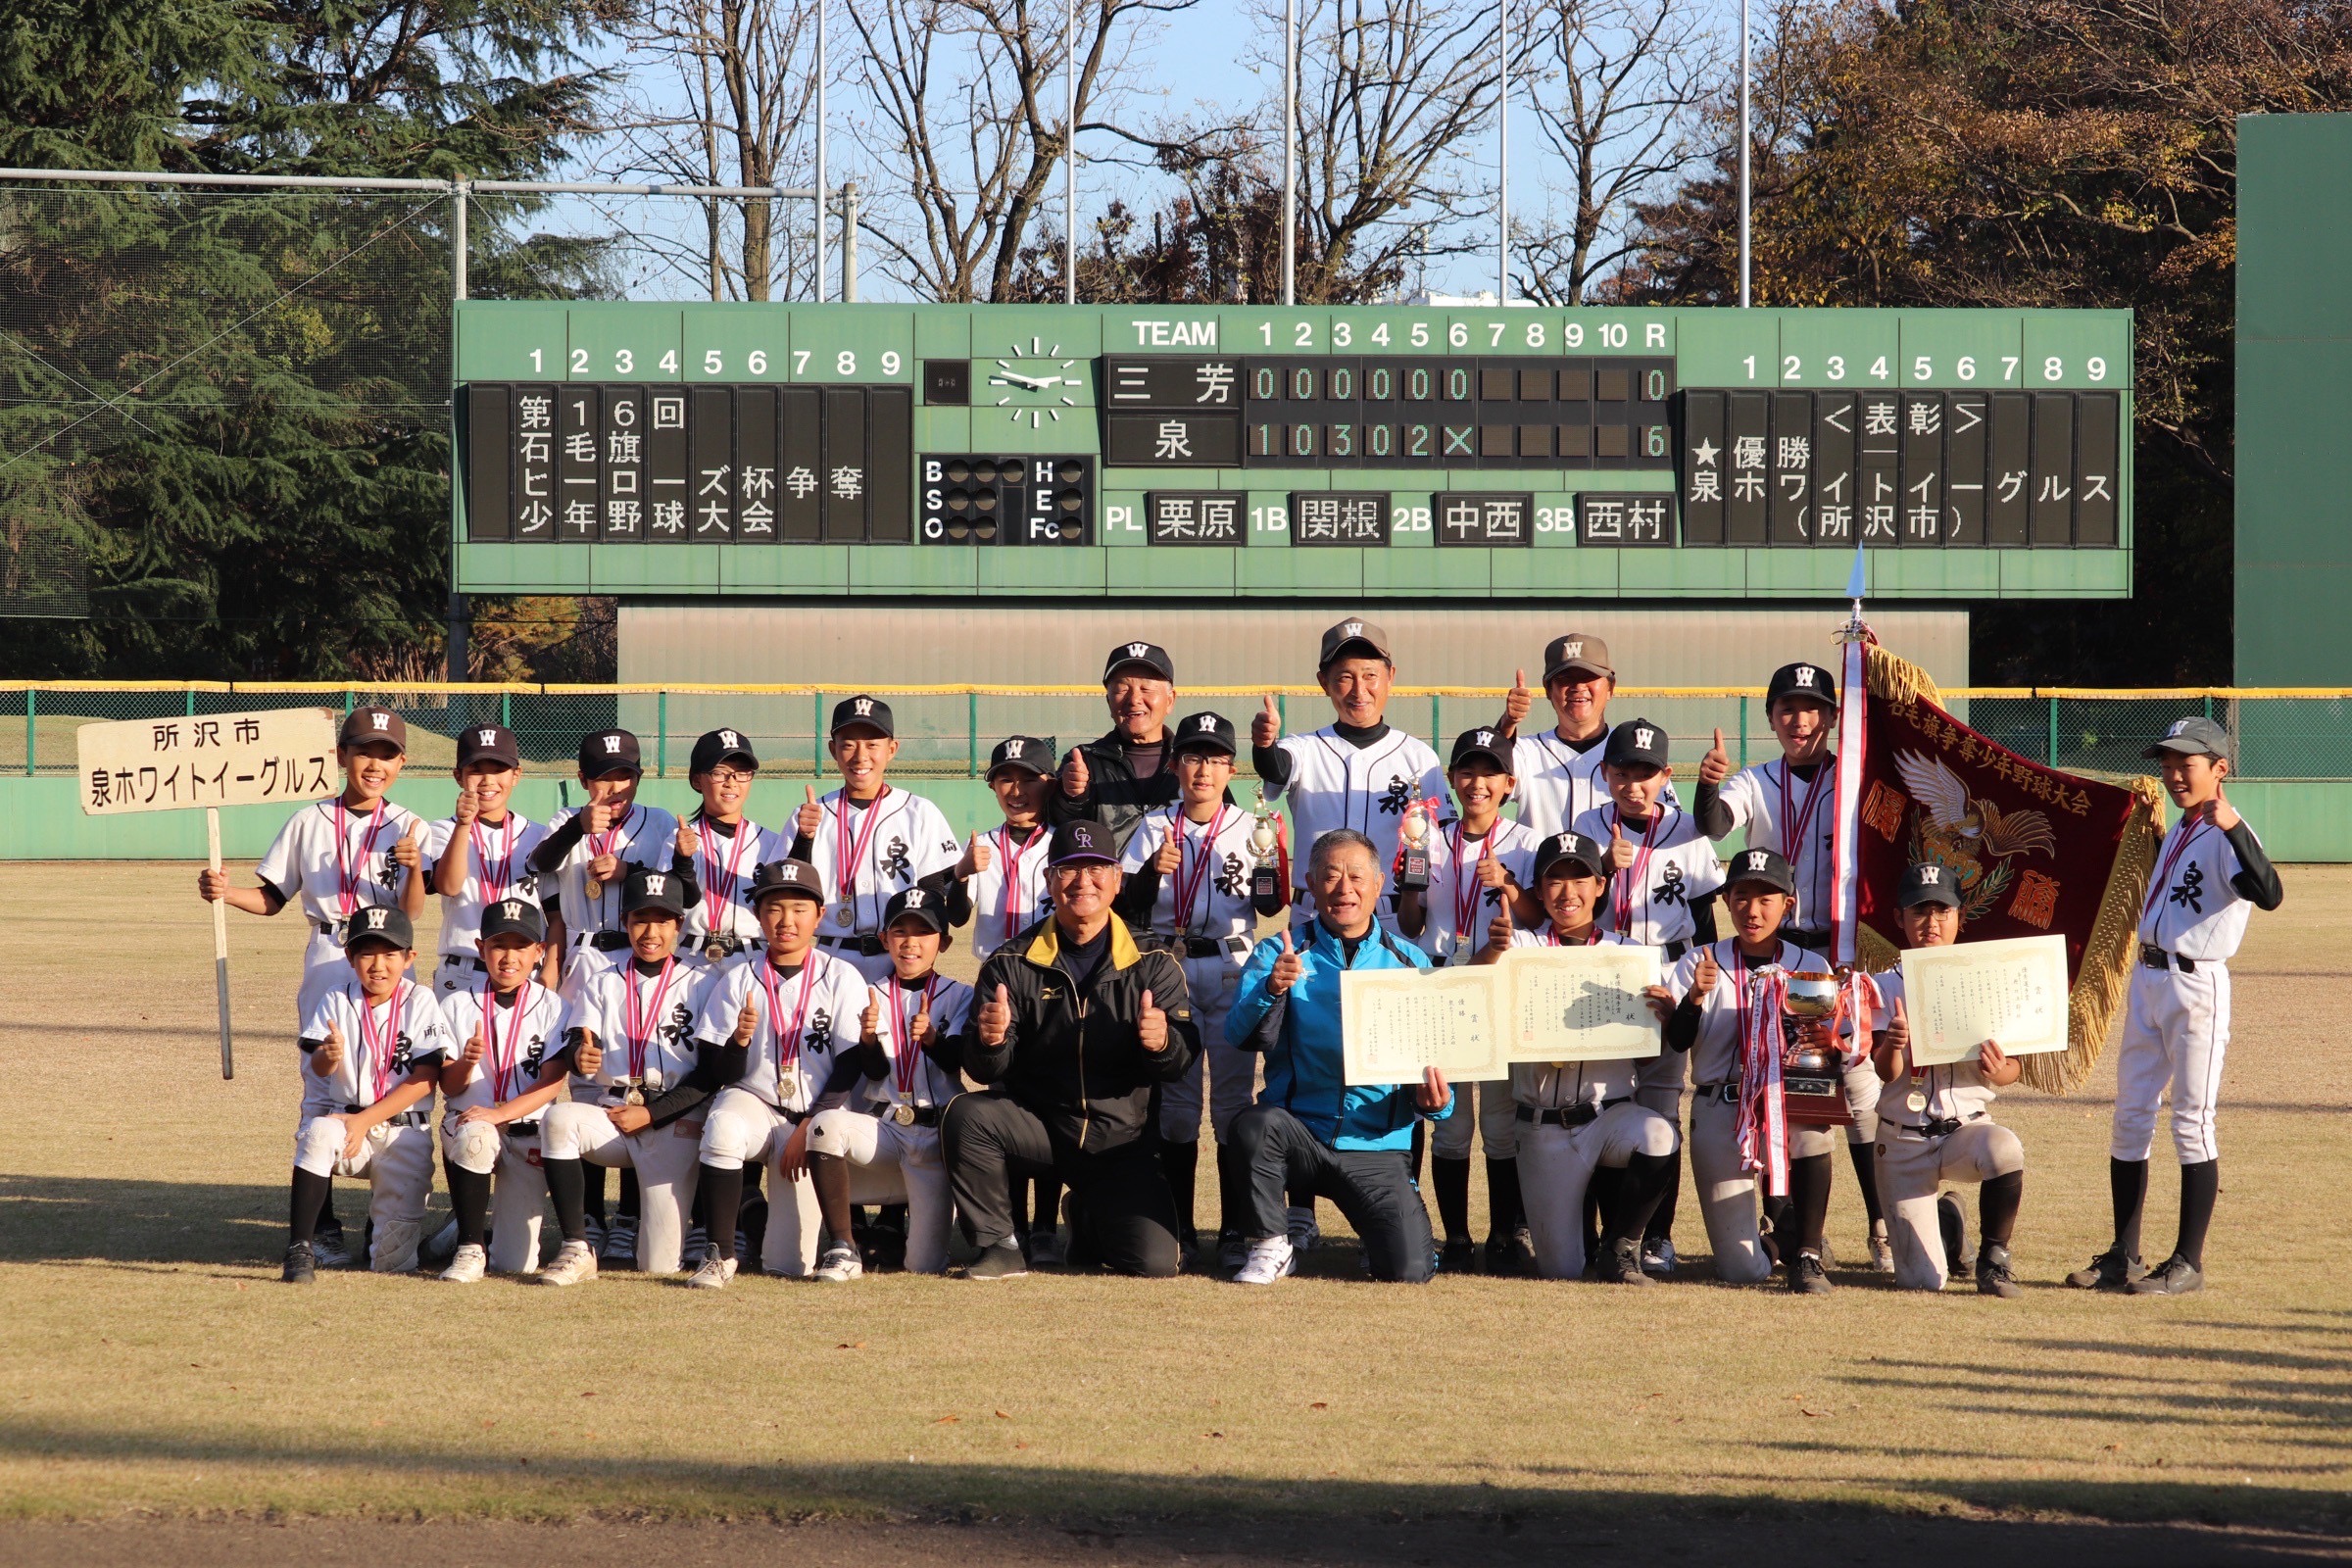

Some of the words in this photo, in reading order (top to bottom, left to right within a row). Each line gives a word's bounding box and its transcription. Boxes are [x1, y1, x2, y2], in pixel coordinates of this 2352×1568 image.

[1131, 320, 1216, 346] TEAM
[1259, 321, 1271, 346] 1
[1295, 321, 1313, 347] 2
[1333, 321, 1352, 347] 3
[1371, 322, 1391, 347] 4
[1410, 322, 1430, 347] 5
[1448, 322, 1468, 348] 6
[1488, 322, 1505, 347] 7
[1526, 322, 1545, 348] 8
[1564, 322, 1584, 348] 9
[1597, 322, 1628, 348] 10
[1645, 323, 1666, 348] R
[529, 348, 542, 373] 1
[570, 348, 589, 373] 2
[614, 349, 634, 374] 3
[659, 349, 678, 374] 4
[704, 350, 723, 374] 5
[748, 350, 767, 375] 6
[793, 350, 811, 375] 7
[836, 350, 857, 375] 8
[881, 350, 901, 376] 9
[1742, 355, 1755, 379] 1
[1784, 355, 1801, 380] 2
[1827, 355, 1845, 380] 3
[1870, 356, 1889, 380] 4
[1914, 356, 1933, 380] 5
[1957, 356, 1976, 381] 6
[2001, 356, 2019, 380] 7
[2043, 356, 2063, 381] 8
[2086, 356, 2106, 381] 9
[1113, 363, 1235, 403] 三芳
[1256, 368, 1274, 400] 0
[1296, 368, 1312, 400] 0
[1334, 368, 1351, 400] 0
[1372, 368, 1390, 400] 0
[1411, 368, 1429, 400] 0
[1450, 368, 1467, 400] 0
[1647, 369, 1665, 401] 0
[519, 396, 684, 429] 第16回
[520, 431, 641, 464] 石毛旗
[1154, 419, 1193, 460] 泉
[1258, 423, 1268, 456] 1
[1296, 424, 1312, 456] 0
[1334, 424, 1351, 456] 3
[1372, 424, 1390, 456] 0
[1411, 424, 1428, 457] 2
[1647, 425, 1665, 457] 6
[525, 466, 863, 500] ヒーローズ杯争奪
[926, 461, 943, 482] B
[1036, 461, 1054, 483] H
[1690, 469, 2111, 504] 泉ホワイトイーグルス
[926, 489, 943, 511] S
[1036, 489, 1054, 512] E
[520, 499, 773, 534] 少年野球大会
[924, 516, 944, 539] O
[1106, 506, 1144, 531] PL
[1156, 499, 1237, 538] 栗原
[1250, 507, 1288, 531] 1B
[1300, 500, 1380, 539] 関根
[1393, 507, 1432, 532] 2B
[1446, 500, 1523, 539] 中西
[1536, 507, 1575, 532] 3B
[1586, 500, 1666, 539] 西村
[1344, 621, 1364, 638] W
[1126, 642, 1150, 659] W
[1563, 641, 1584, 659] W
[1795, 666, 1816, 687] W
[855, 698, 874, 716] W
[371, 712, 390, 731] W
[1199, 714, 1217, 733] W
[153, 717, 261, 752] 所沢市
[477, 728, 497, 747] W
[603, 735, 621, 754] W
[717, 730, 740, 750] W
[1476, 730, 1494, 748] W
[1635, 727, 1654, 751] W
[1004, 737, 1025, 760] W
[91, 756, 329, 808] 泉ホワイトイーグルス
[1377, 773, 1409, 816] 泉
[1556, 832, 1580, 855] W
[879, 835, 911, 885] 泉
[1748, 851, 1769, 871] W
[780, 863, 799, 882] W
[1213, 851, 1245, 901] 泉
[1651, 858, 1687, 908] 泉
[1922, 865, 1940, 885] W
[645, 874, 666, 896] W
[2169, 859, 2204, 914] 泉
[905, 889, 926, 908] W
[366, 907, 389, 930] W
[501, 901, 524, 922] W
[659, 1002, 695, 1053] 泉
[804, 1006, 832, 1055] 泉
